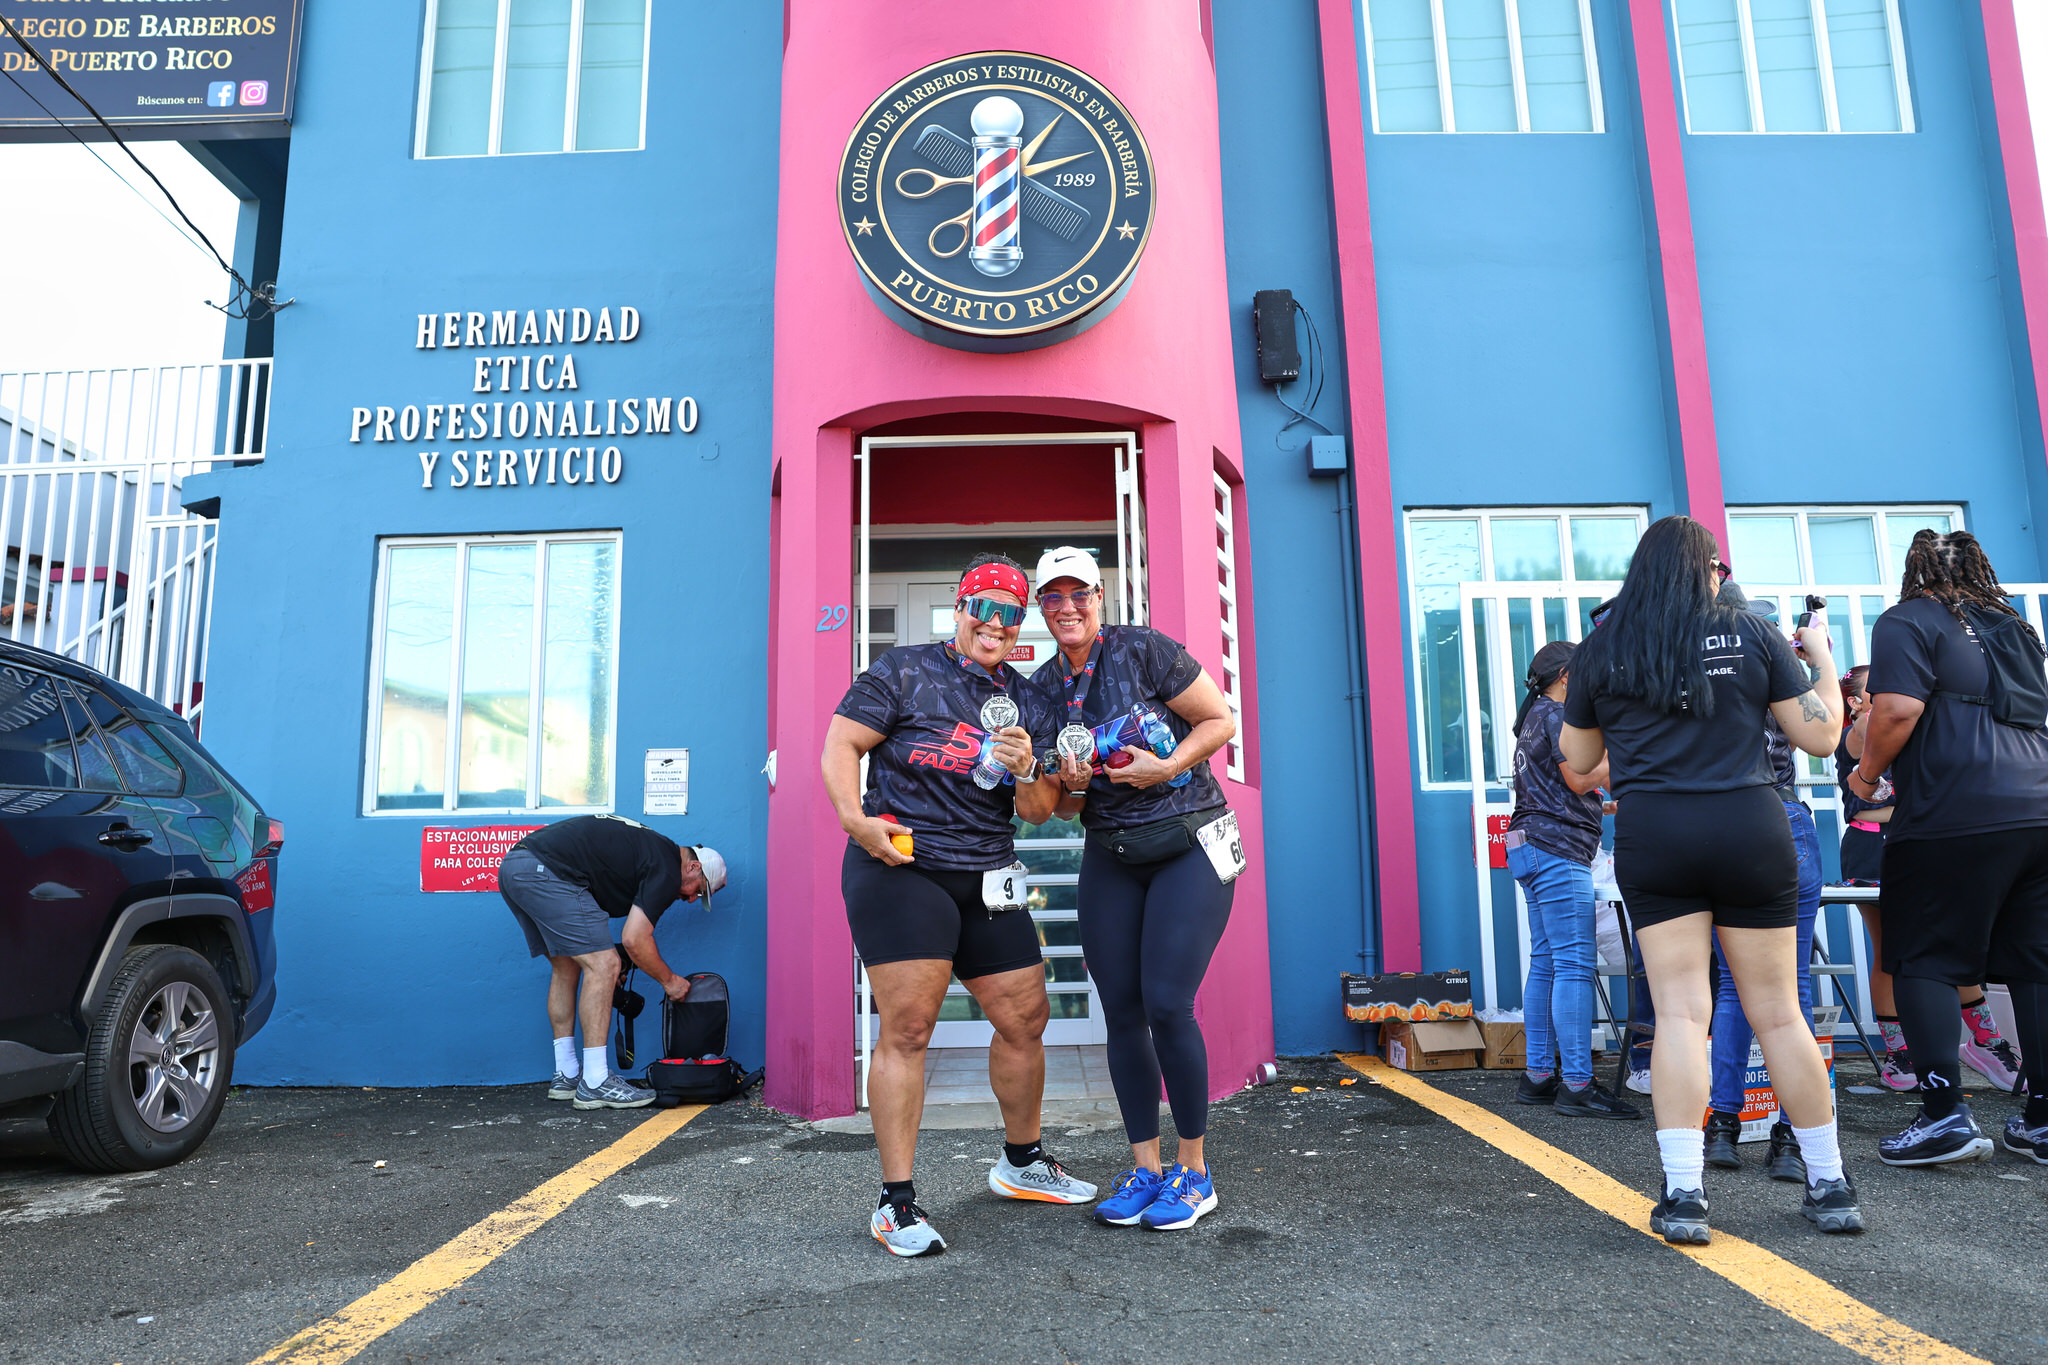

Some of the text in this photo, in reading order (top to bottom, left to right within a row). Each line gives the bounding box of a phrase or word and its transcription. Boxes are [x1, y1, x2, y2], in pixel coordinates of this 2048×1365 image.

[0, 14, 277, 38] LEGIO DE BARBEROS
[2, 47, 233, 72] DE PUERTO RICO
[137, 95, 185, 106] Búscanos
[187, 97, 203, 105] en:
[851, 65, 1143, 203] COLEGIO DE BARBEROS Y ESTILISTAS EN BARBERÍA
[1053, 173, 1096, 187] 1989
[890, 269, 1099, 322] PUERTO RICO
[415, 306, 641, 349] HERMANDAD
[472, 353, 579, 393] ETICA
[349, 396, 699, 443] PROFESIONALISMO
[418, 445, 623, 488] Y SERVICIO
[816, 604, 849, 632] 29
[1701, 634, 1742, 652] DIO
[941, 721, 1000, 763] 5
[908, 749, 975, 775] FADE
[650, 783, 681, 791] AVISO
[426, 830, 536, 843] ESTACIONAMIEN
[1488, 834, 1505, 844] PAR
[434, 857, 503, 868] PARA COLEG
[462, 876, 475, 886] LEY
[1003, 876, 1014, 900] 9
[1746, 1092, 1774, 1102] BO 2-PLY
[1755, 1102, 1776, 1111] PAPER
[1020, 1171, 1072, 1188] BROOKS
